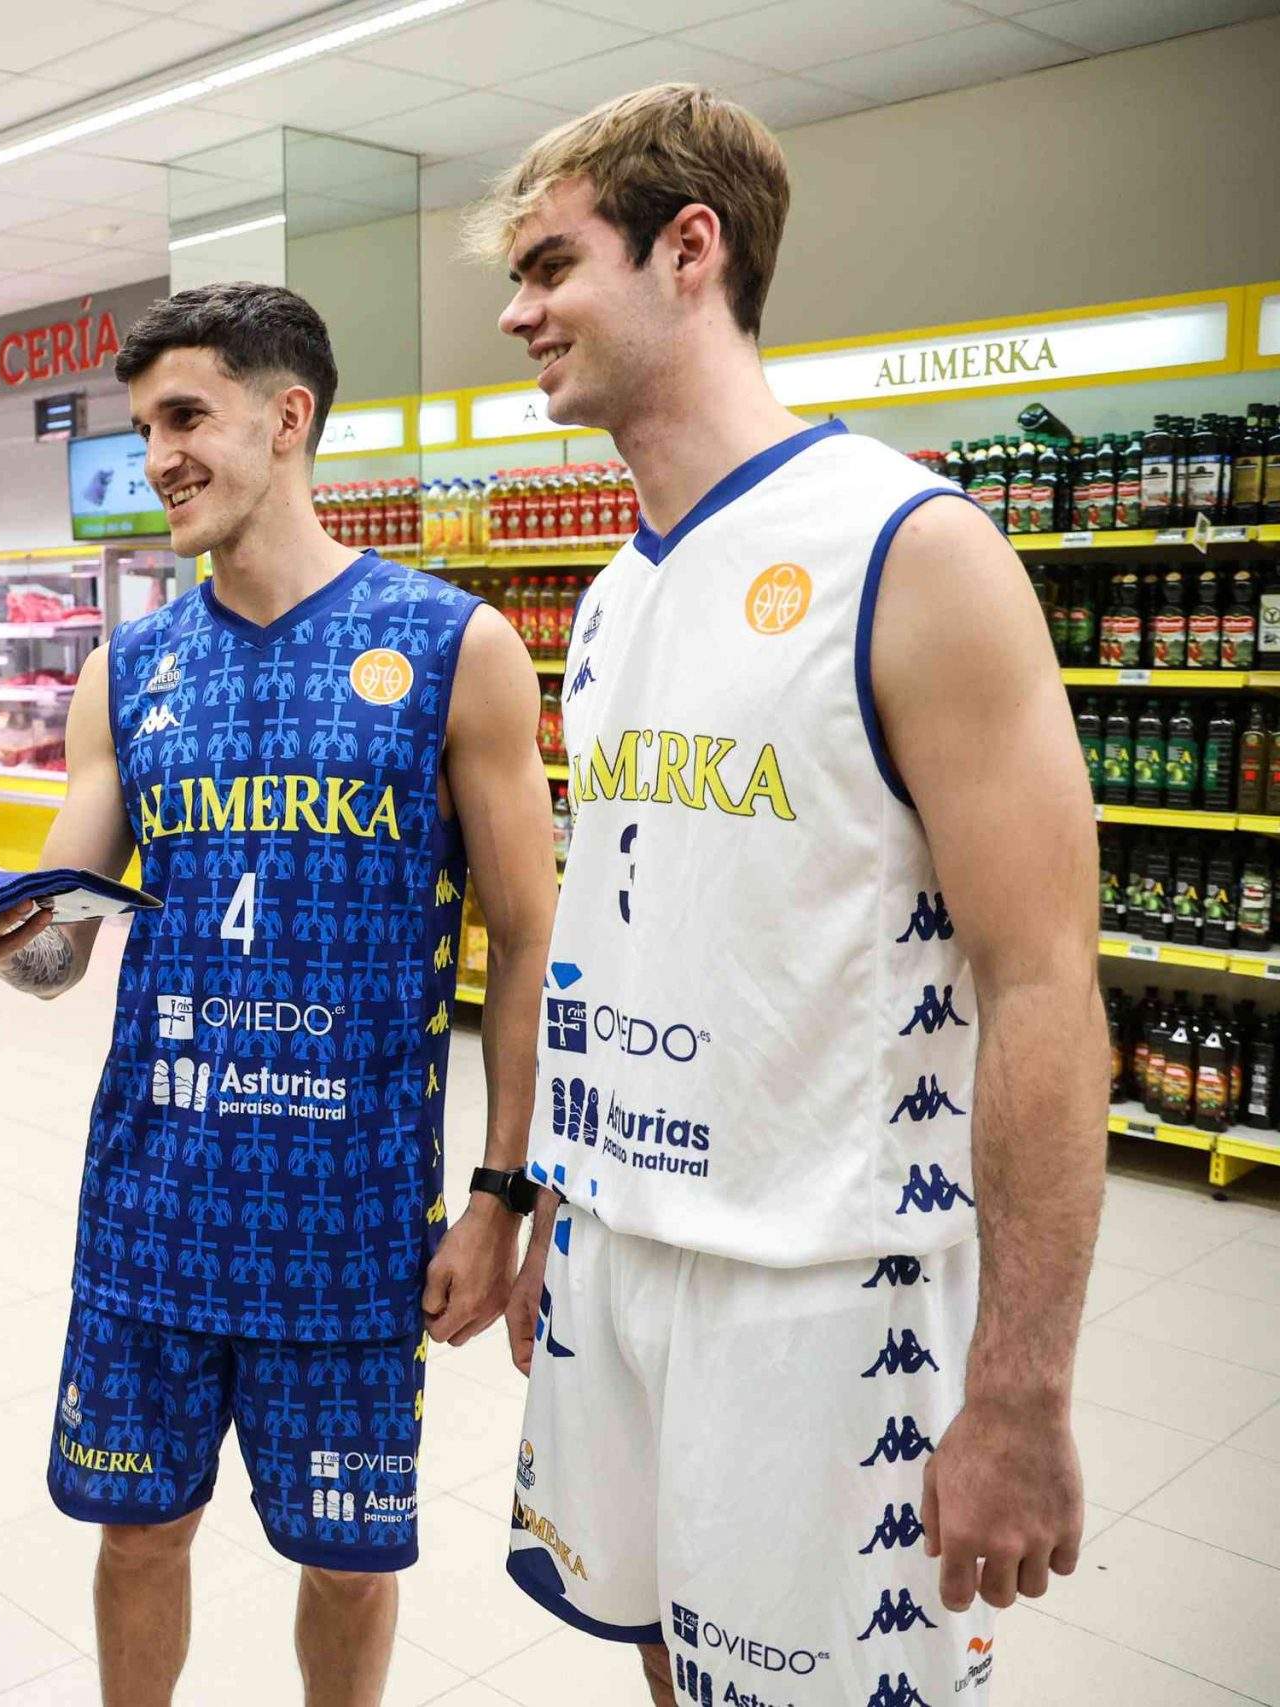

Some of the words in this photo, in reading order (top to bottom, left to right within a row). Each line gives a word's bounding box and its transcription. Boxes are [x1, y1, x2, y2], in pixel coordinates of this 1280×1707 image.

[873, 336, 1059, 388] ALIMERKA
[140, 774, 401, 846] ALIMERKA
[220, 872, 257, 956] 4
[219, 1061, 347, 1100] Asturias
[288, 1101, 346, 1122] natural
[632, 1150, 710, 1178] natural
[344, 1451, 417, 1475] OVIED
